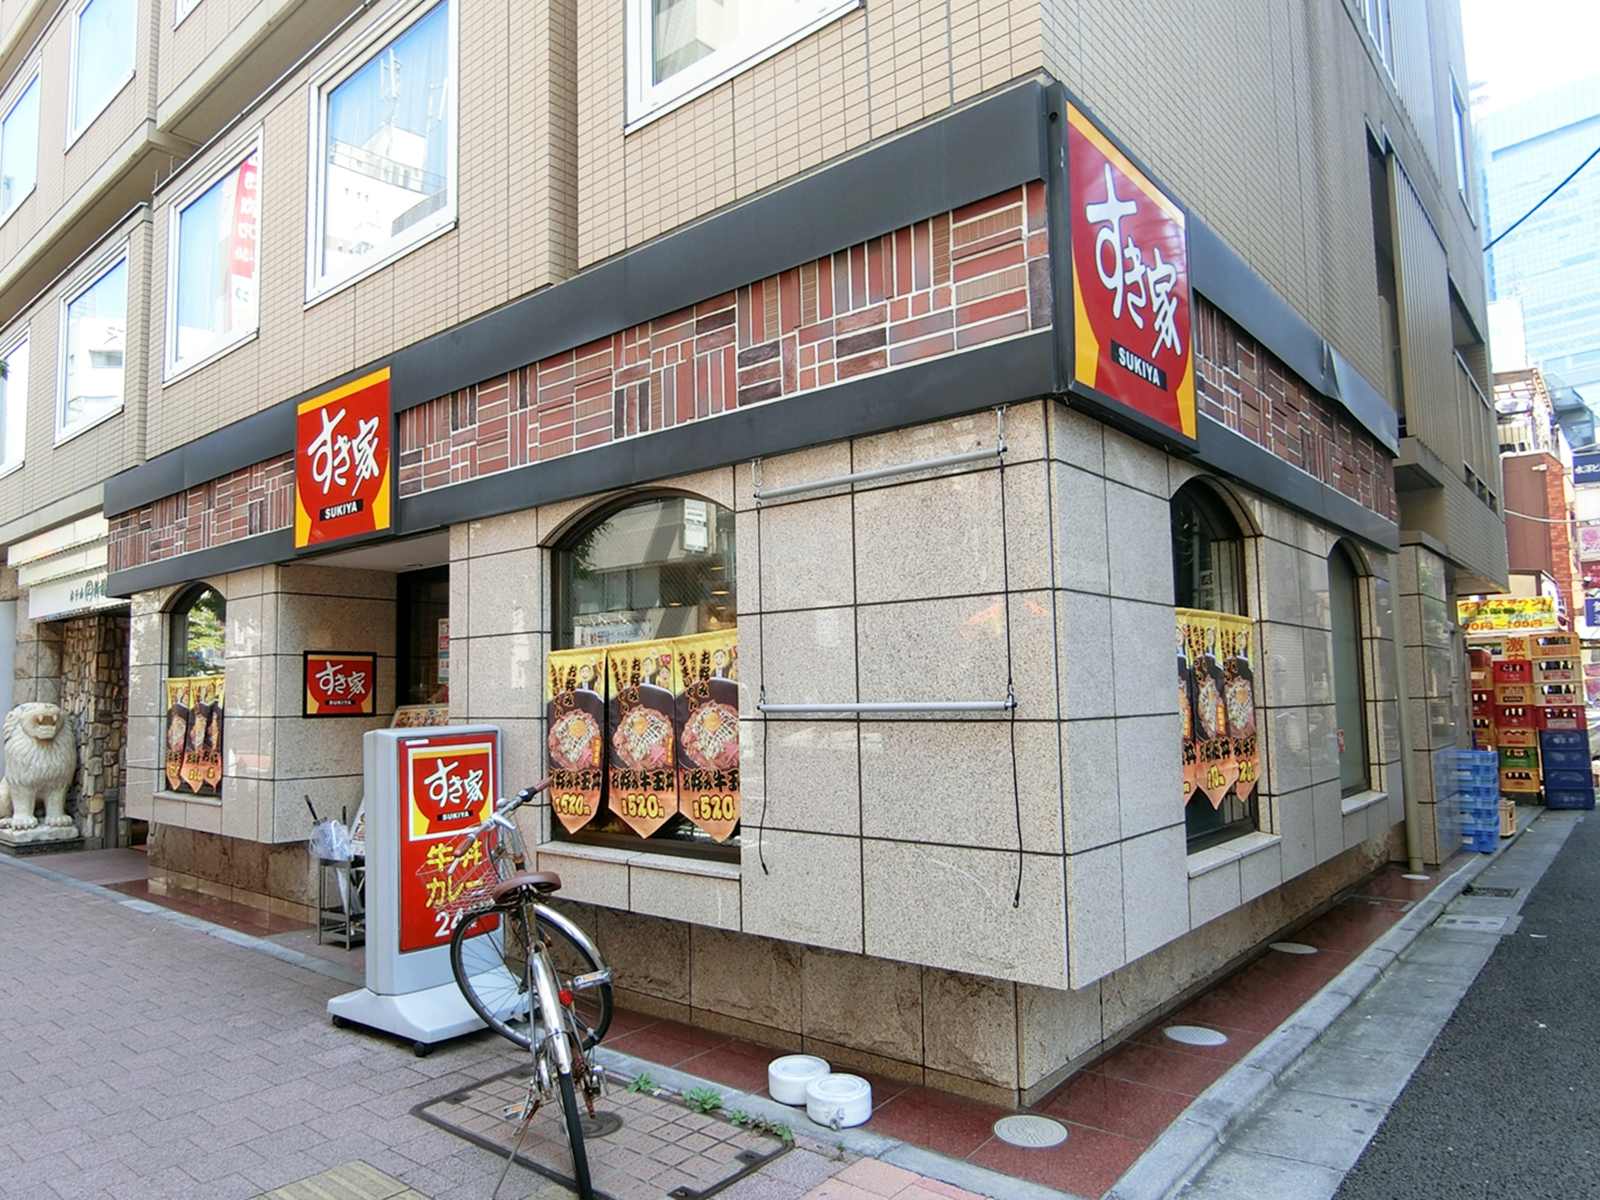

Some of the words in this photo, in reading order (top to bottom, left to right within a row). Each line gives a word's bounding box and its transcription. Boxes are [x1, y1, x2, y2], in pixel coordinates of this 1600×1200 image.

[1085, 162, 1182, 359] すき家
[1117, 347, 1161, 387] SUKIYA
[307, 407, 380, 497] すき家
[324, 501, 358, 520] SUKIYA
[315, 660, 366, 699] すき家
[423, 758, 484, 809] すき家
[441, 811, 470, 821] SUKIYA
[425, 875, 484, 908] カレー
